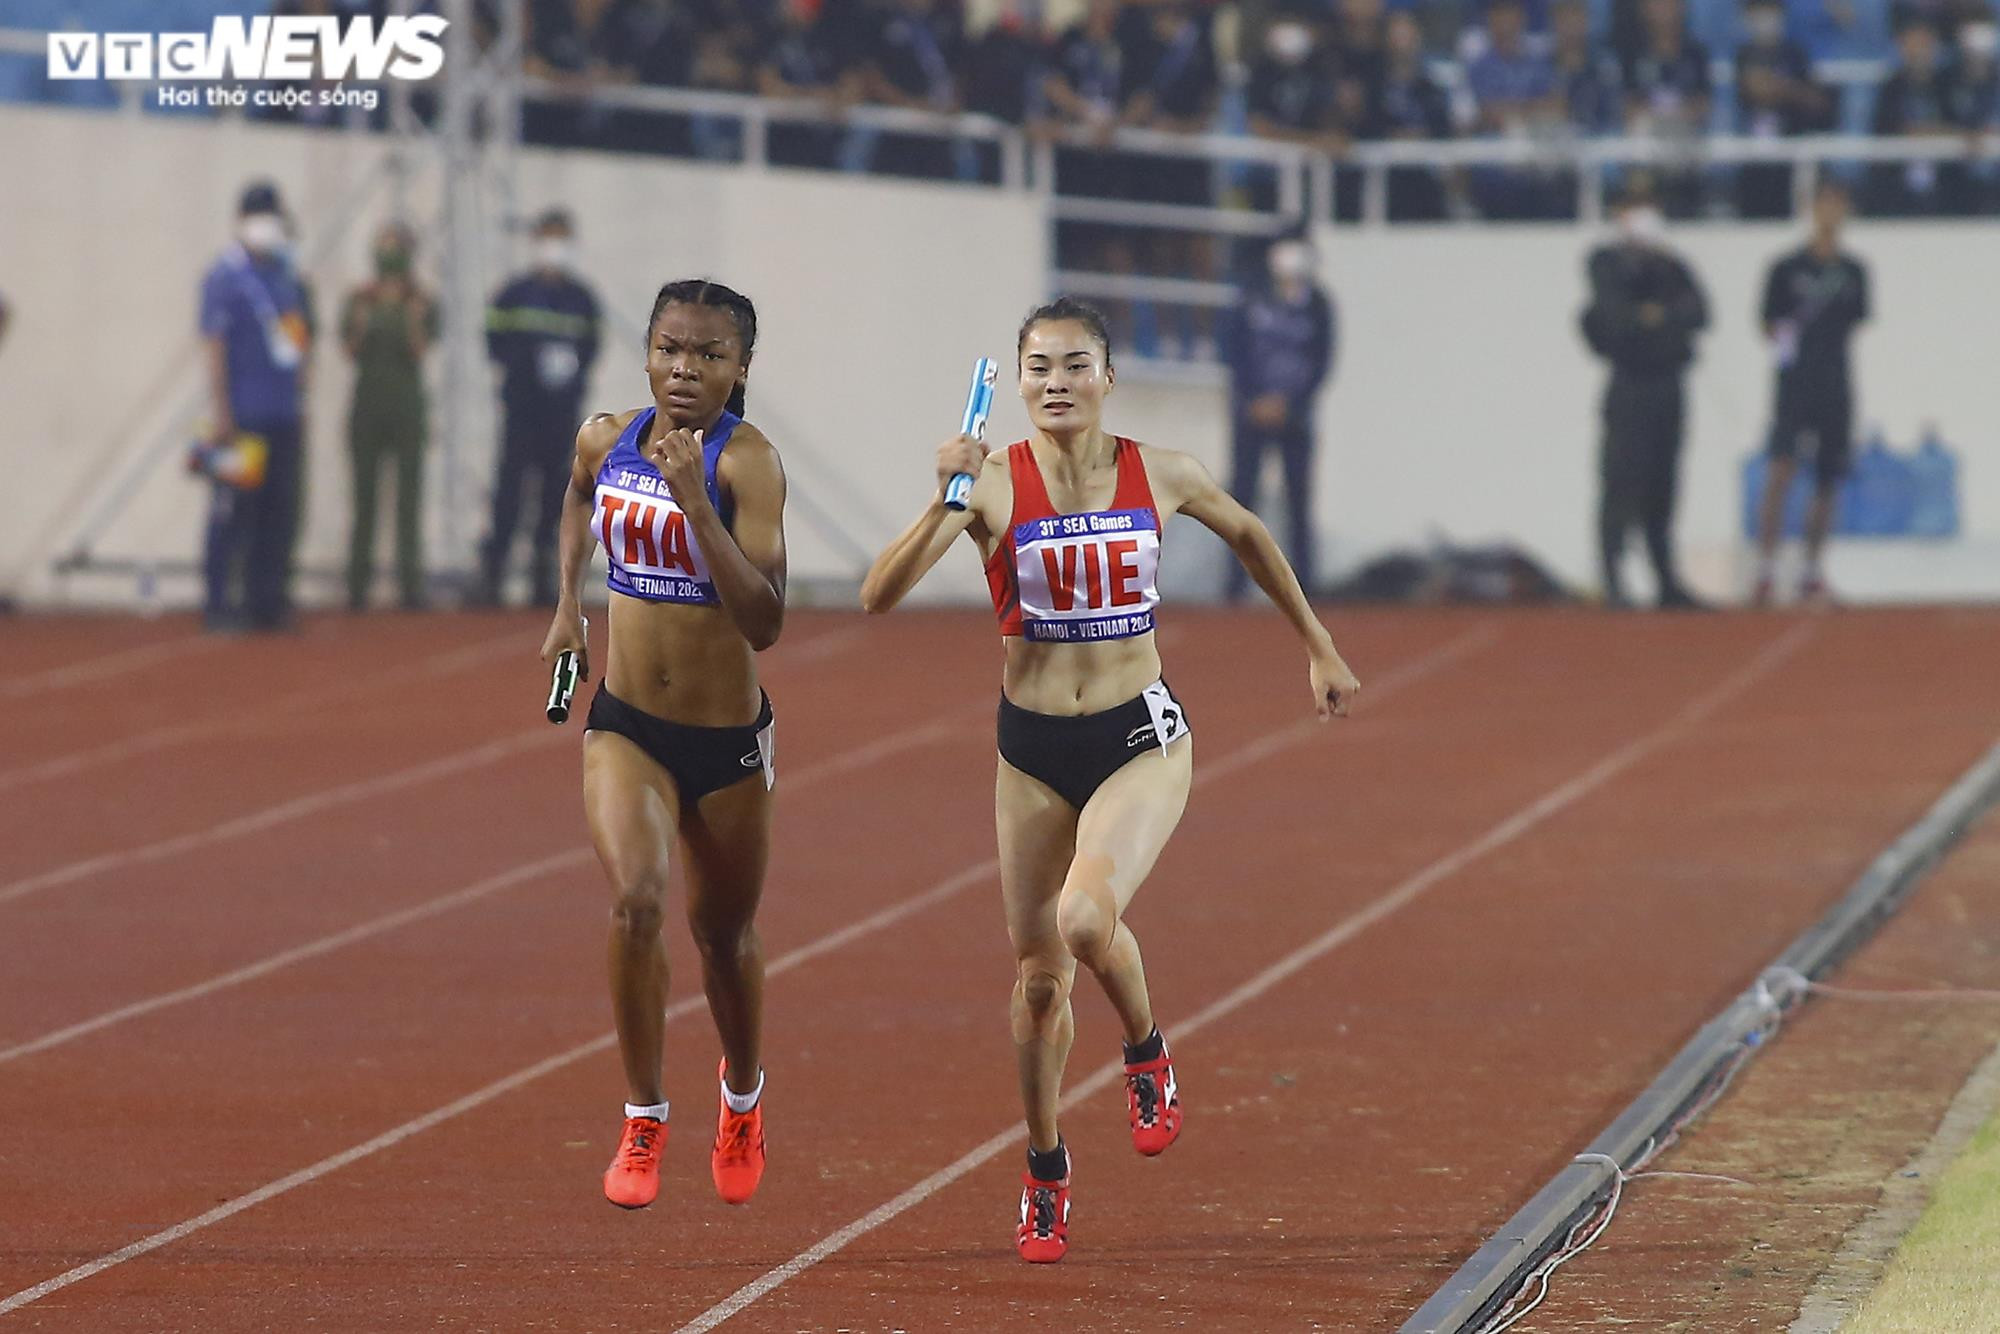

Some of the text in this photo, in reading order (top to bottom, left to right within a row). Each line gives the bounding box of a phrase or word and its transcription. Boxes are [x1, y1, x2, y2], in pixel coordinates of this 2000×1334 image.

[636, 474, 657, 494] SEA
[601, 494, 697, 577] THA
[1062, 516, 1088, 534] SEA
[1089, 515, 1133, 531] Games
[1040, 539, 1142, 612] VIE
[1034, 623, 1070, 639] HANOI
[1079, 617, 1129, 638] VIETNAM
